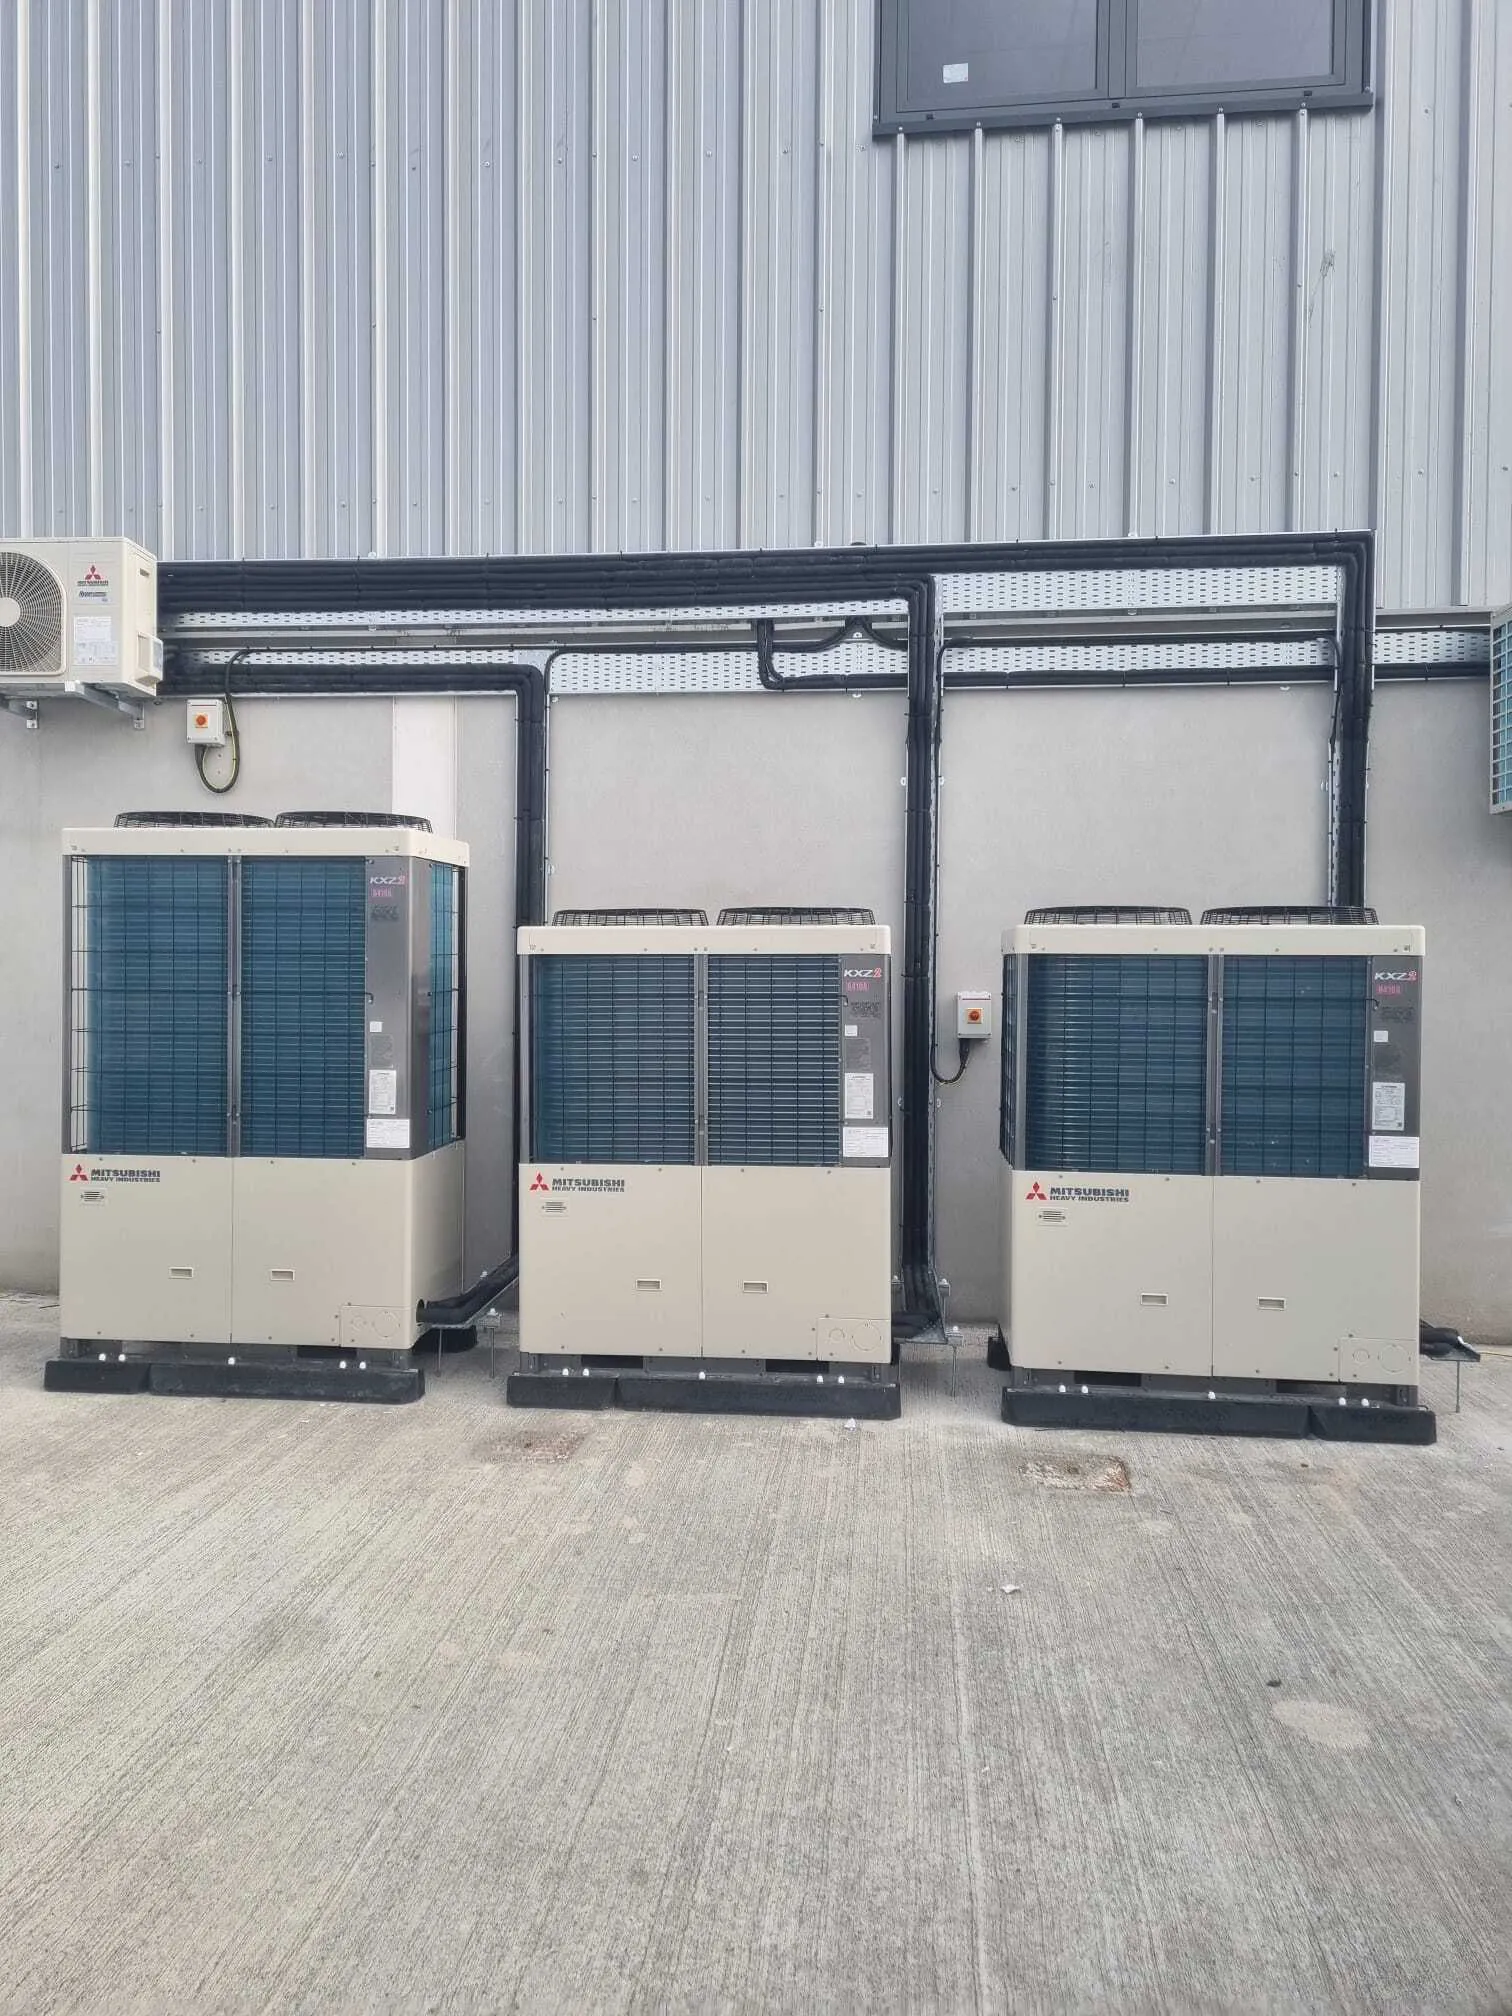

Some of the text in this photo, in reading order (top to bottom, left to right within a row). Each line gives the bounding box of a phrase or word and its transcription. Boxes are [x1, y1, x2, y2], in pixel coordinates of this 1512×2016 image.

[91, 1169, 161, 1178] MITSUBISHI
[552, 1178, 625, 1187] MITSUBISHI
[1050, 1187, 1130, 1197] MITSUBISHI
